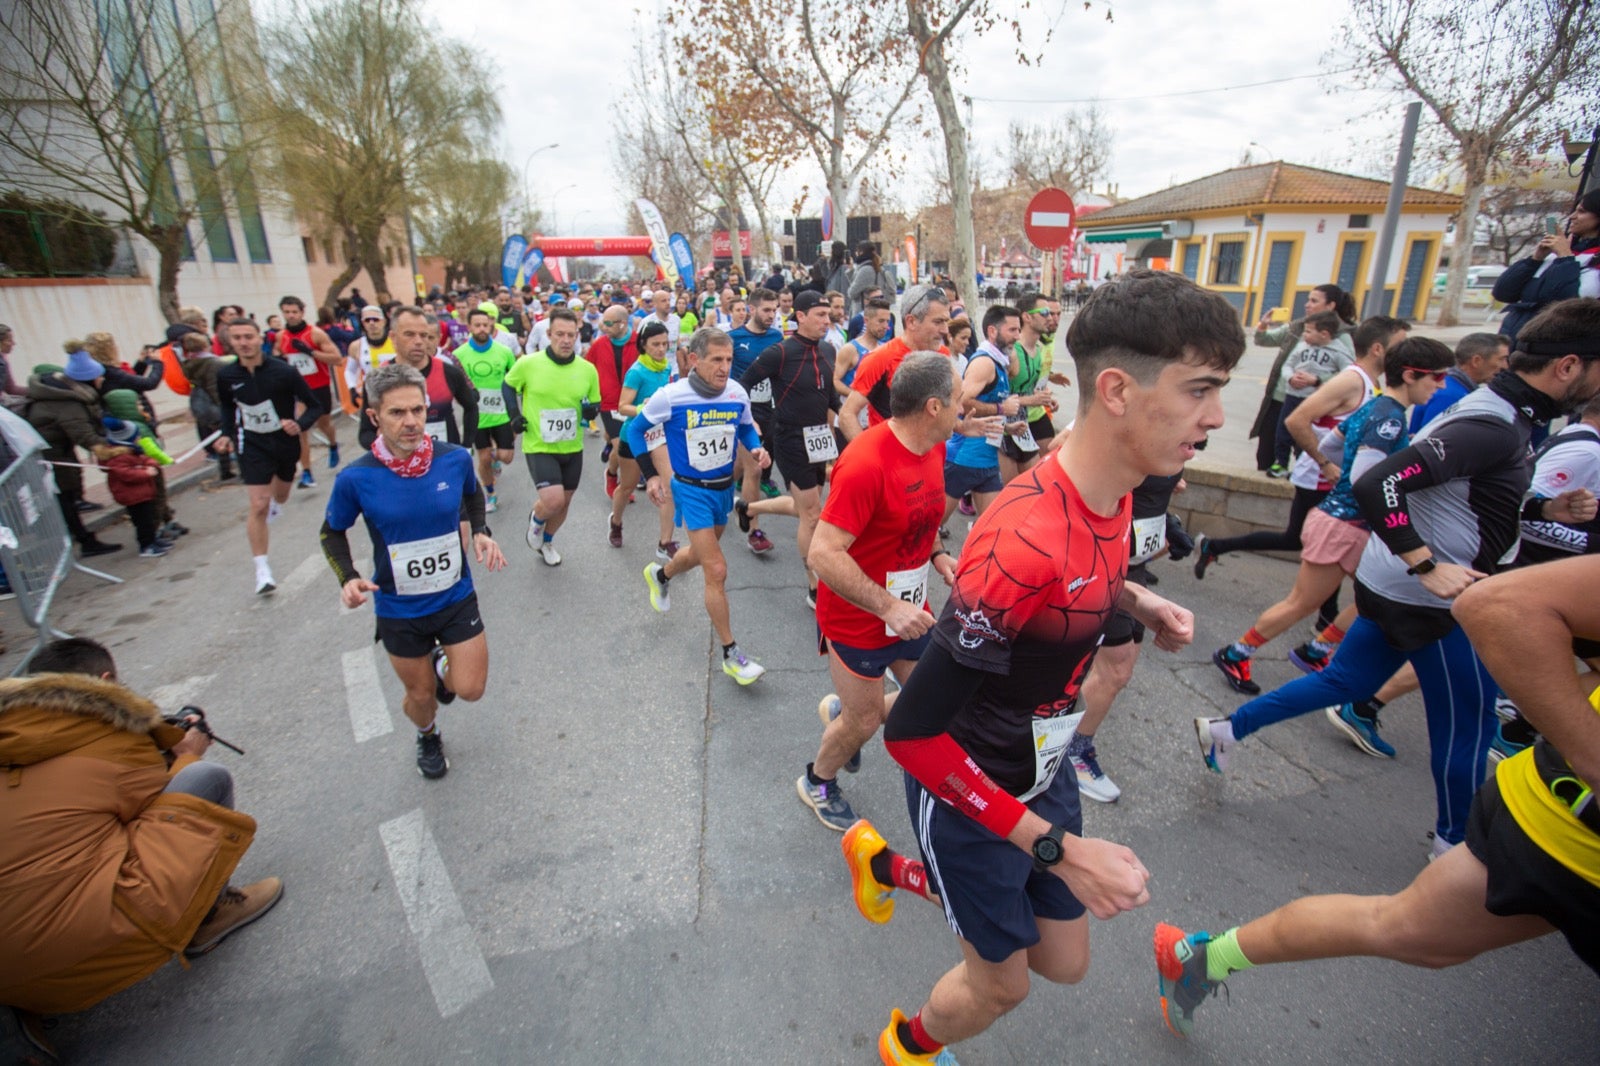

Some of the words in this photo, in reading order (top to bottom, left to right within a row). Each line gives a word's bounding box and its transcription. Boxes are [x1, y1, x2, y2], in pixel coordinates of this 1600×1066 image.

[1300, 349, 1330, 365] GAP
[482, 396, 501, 406] 662
[702, 409, 738, 421] olimpo
[547, 419, 572, 431] 790
[644, 429, 666, 442] 203
[698, 437, 728, 457] 314
[807, 435, 833, 452] 3097
[407, 551, 451, 579] 695
